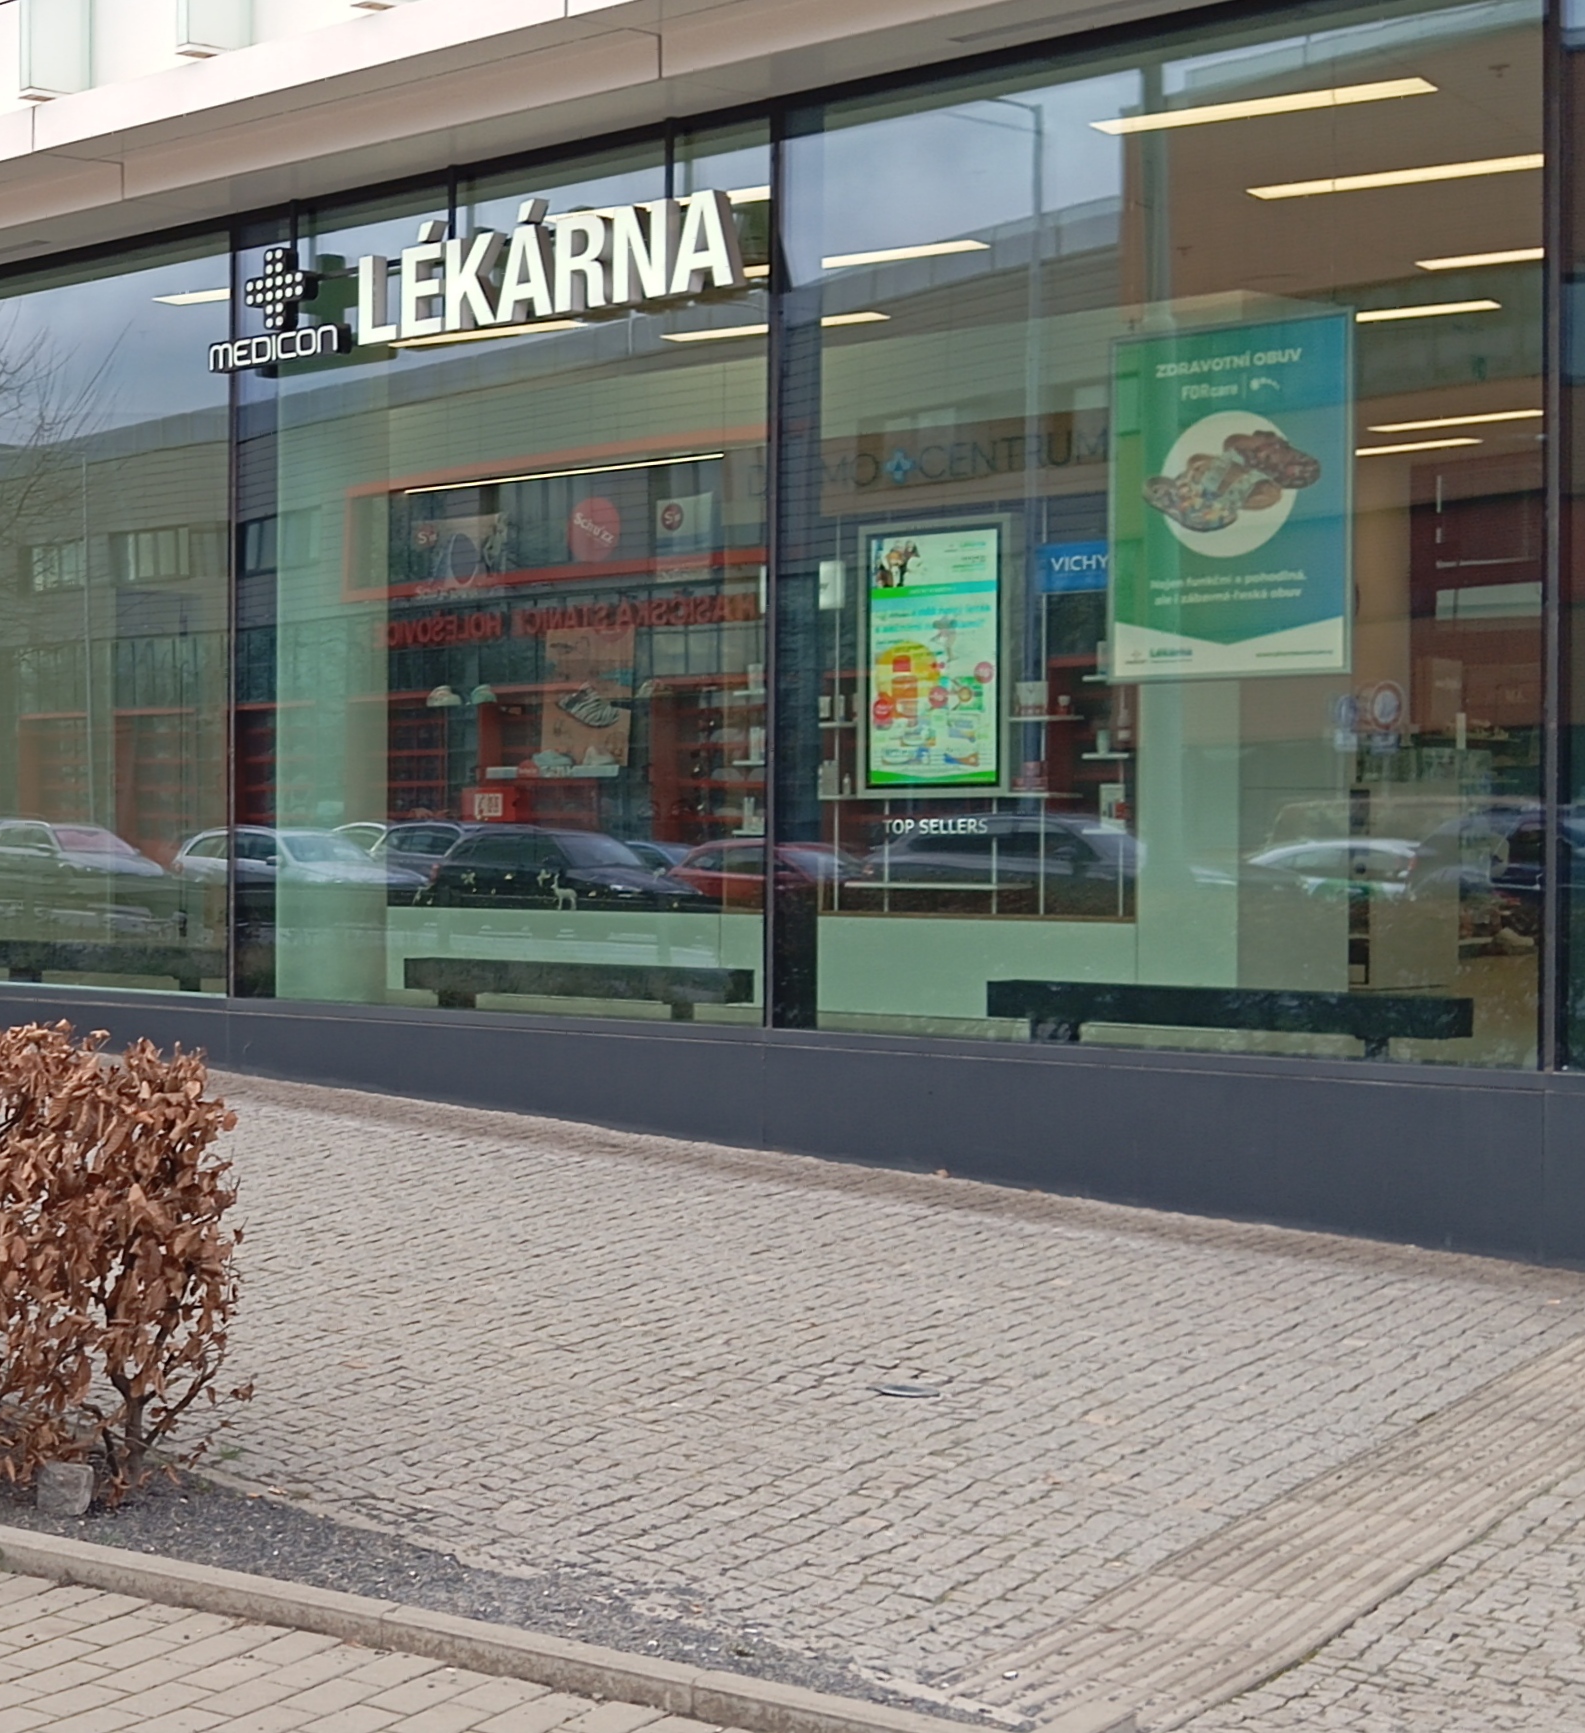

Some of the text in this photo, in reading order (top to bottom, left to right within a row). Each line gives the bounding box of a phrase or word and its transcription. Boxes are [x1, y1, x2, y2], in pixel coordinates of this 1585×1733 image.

[358, 189, 736, 346] LÉKÁRNA
[208, 323, 339, 374] MEDICON
[1155, 347, 1302, 378] ZDRAVOTNÍ OBUV
[1050, 552, 1109, 572] VICHY
[882, 818, 989, 834] TOP SELLERS
